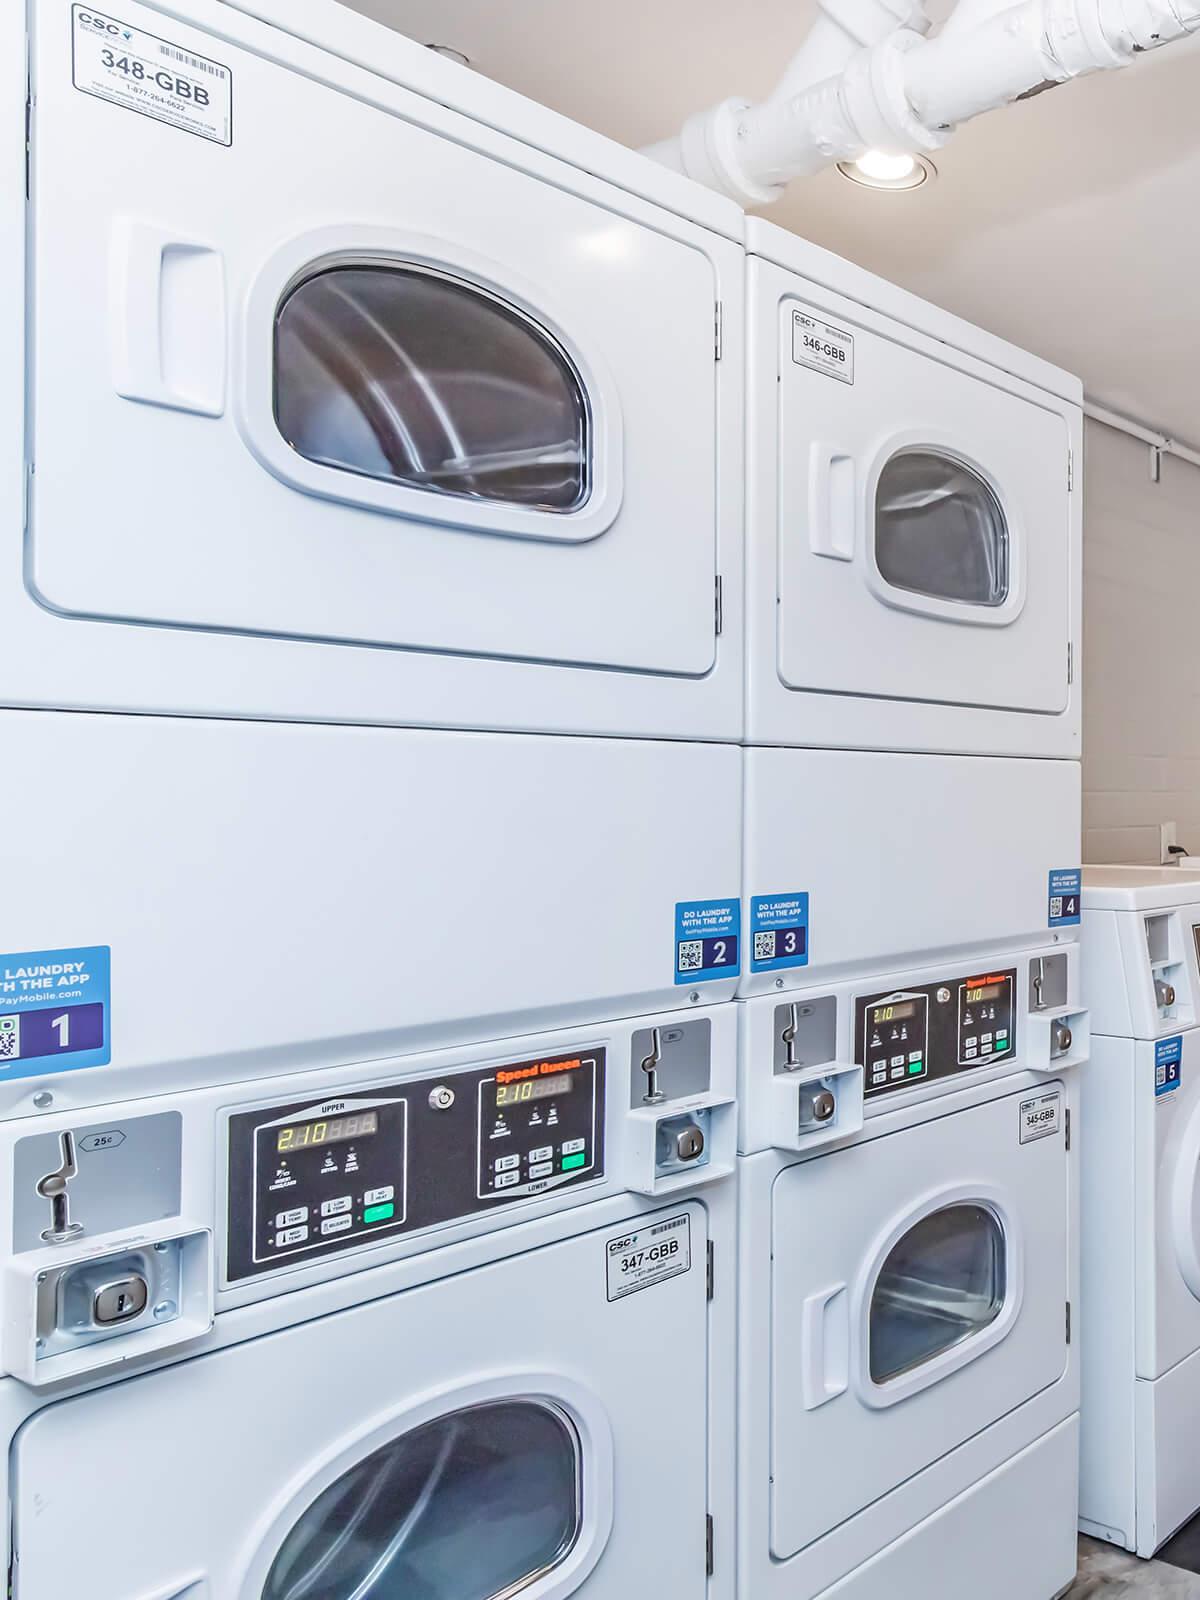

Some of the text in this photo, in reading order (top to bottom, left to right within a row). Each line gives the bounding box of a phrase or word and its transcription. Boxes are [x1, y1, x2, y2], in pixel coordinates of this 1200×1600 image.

[78, 12, 120, 35] CSC
[101, 49, 210, 106] 348-GBB
[795, 315, 811, 326] CSC
[803, 335, 845, 361] 346-GBB
[684, 908, 731, 919] DO LAUNDRY
[770, 901, 799, 910] LAUNDRY
[1066, 898, 1075, 913] 4
[682, 915, 733, 927] WITH THE APP
[757, 910, 774, 919] WITH
[775, 909, 788, 917] THE
[785, 932, 796, 953] 3
[713, 941, 727, 964] 2
[5, 962, 85, 980] LAUNDRY
[20, 977, 54, 990] THE
[57, 974, 90, 987] APP
[52, 1013, 69, 1047] 1
[496, 1059, 581, 1084] Speed Queen
[1169, 1064, 1176, 1080] 5
[321, 1103, 345, 1113] UPPER
[1026, 1109, 1055, 1126] 345-GBB
[528, 1181, 548, 1192] LOWER
[609, 1238, 631, 1252] CSC
[621, 1240, 679, 1273] 347-GBB
